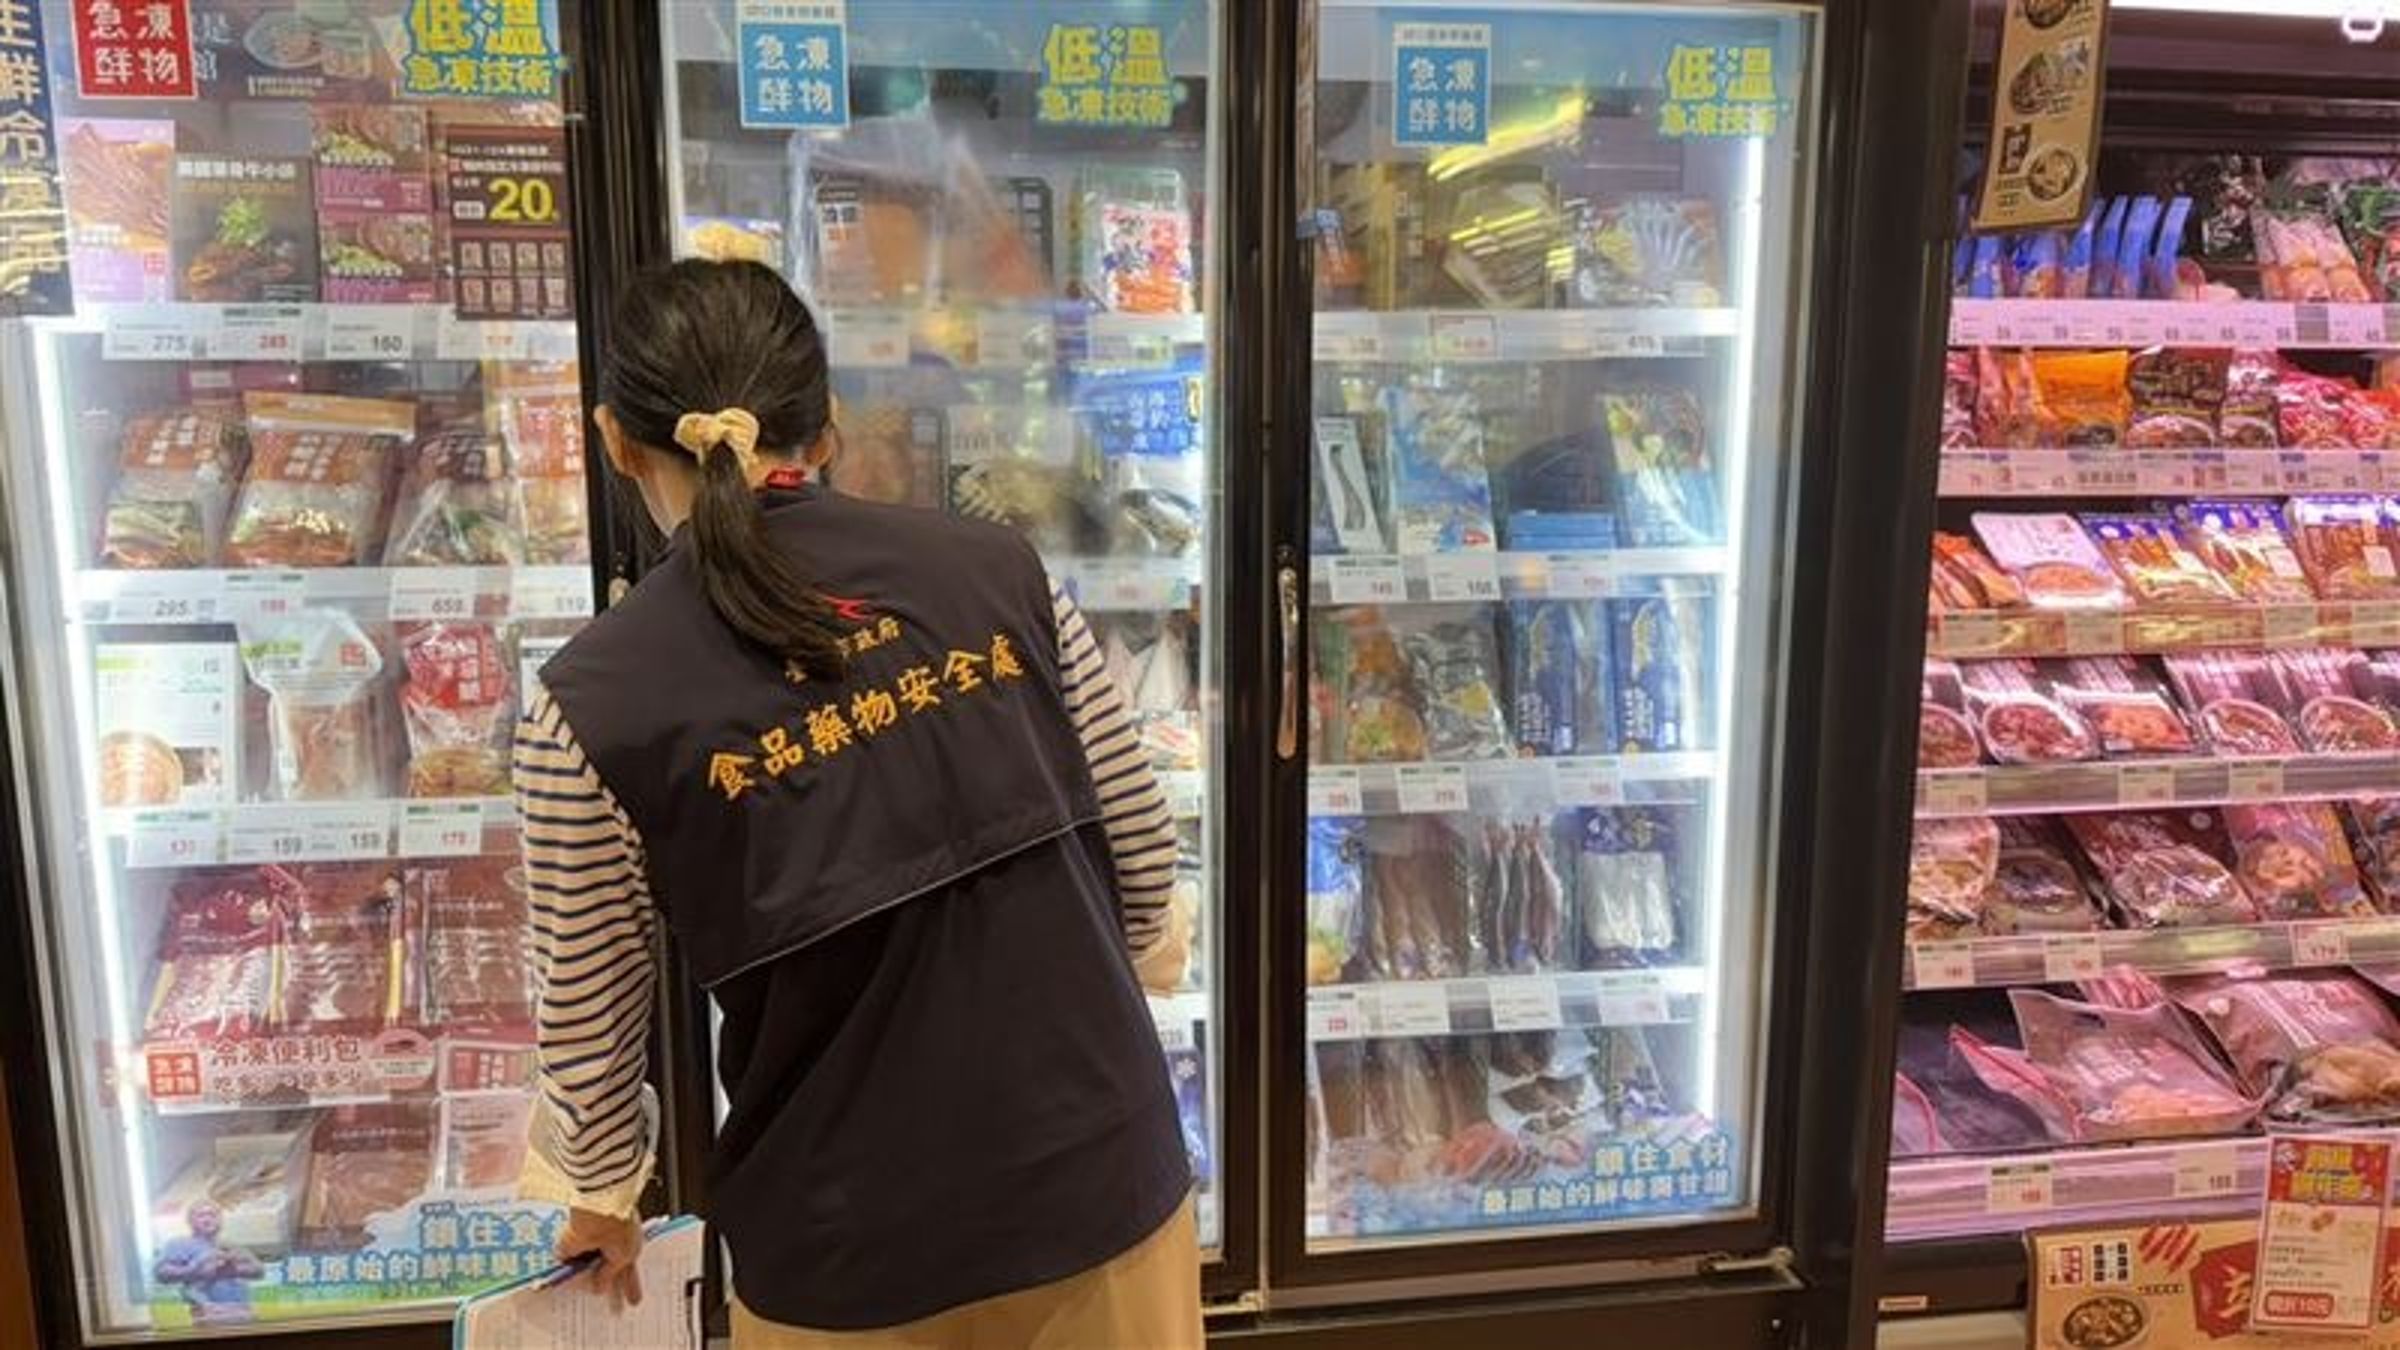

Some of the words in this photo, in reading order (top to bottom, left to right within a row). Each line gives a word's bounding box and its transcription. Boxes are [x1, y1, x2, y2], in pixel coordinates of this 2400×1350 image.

[93, 46, 181, 85] 鮮物
[753, 34, 832, 70] 急凍
[1044, 24, 1168, 84] 低溫
[406, 54, 552, 93] 急凍技術
[757, 78, 834, 115] 鮮物
[1037, 86, 1173, 128] 急凍技術
[488, 178, 553, 220] 20
[708, 632, 1024, 800] 食品藥物安全處
[210, 1033, 362, 1068] 冷凍便利包
